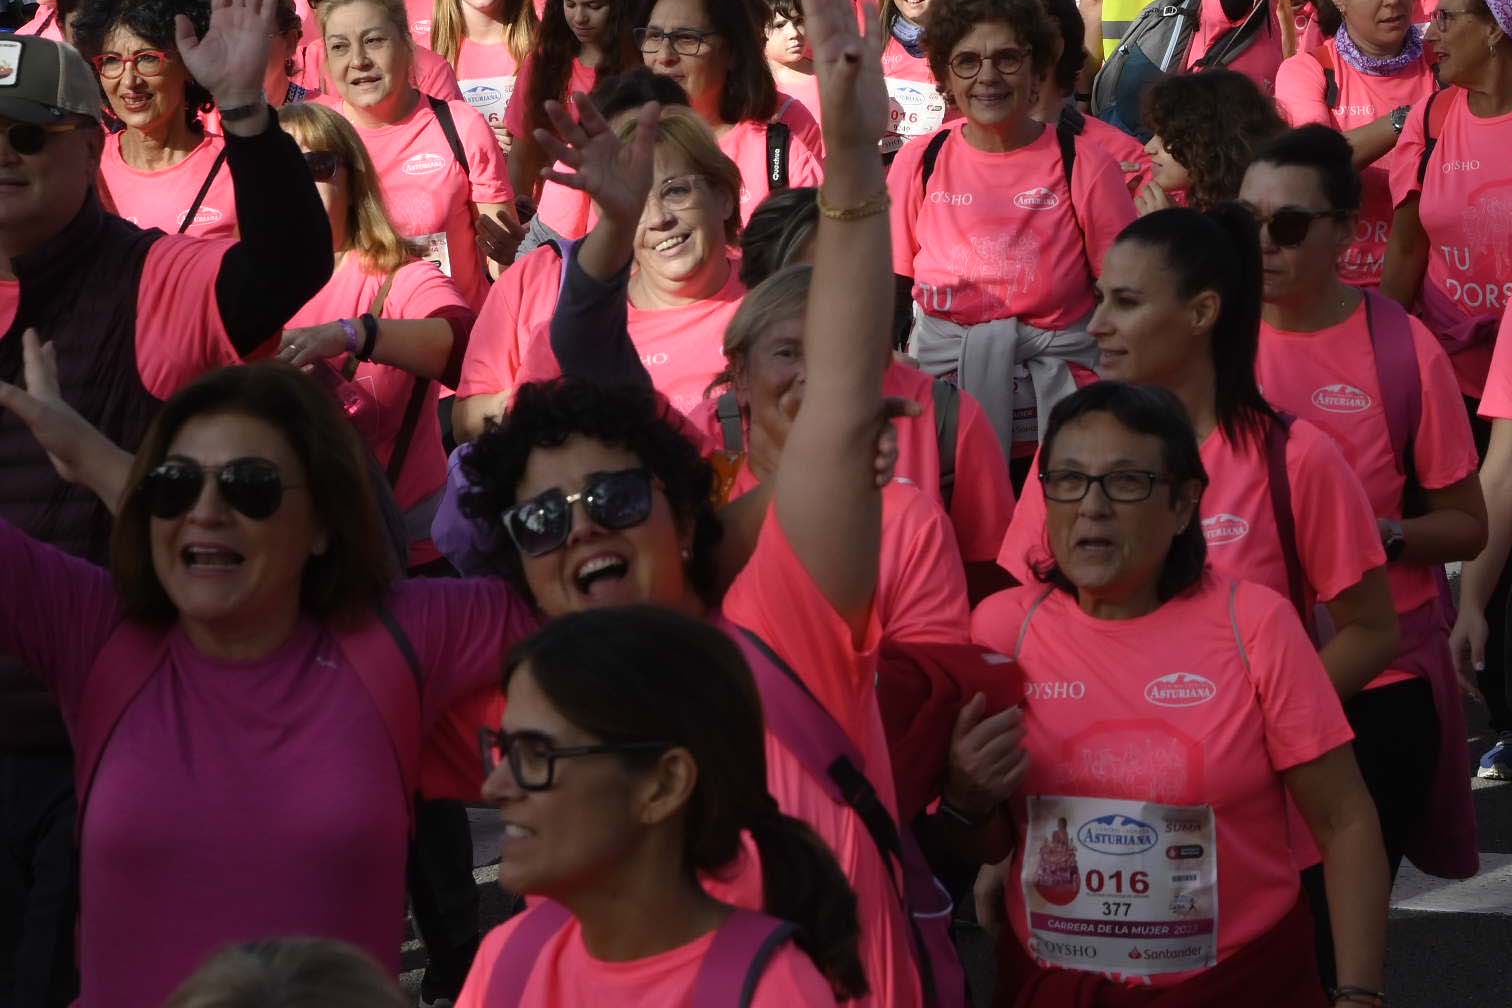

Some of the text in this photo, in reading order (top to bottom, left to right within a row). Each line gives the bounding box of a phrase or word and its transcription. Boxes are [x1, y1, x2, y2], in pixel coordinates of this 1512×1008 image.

[1441, 246, 1471, 271] TU
[1316, 393, 1370, 410] ASTURIANA
[1150, 684, 1211, 700] ASTURIANA
[1084, 829, 1151, 846] ASTURIANA
[1085, 869, 1150, 894] 016
[1102, 902, 1132, 916] 377
[1047, 920, 1095, 933] CARRERA
[1097, 924, 1112, 934] DE
[1115, 925, 1129, 935] LA
[1131, 925, 1169, 935] MUJER
[1043, 942, 1097, 958] OYSHO
[1143, 945, 1203, 960] Santander
